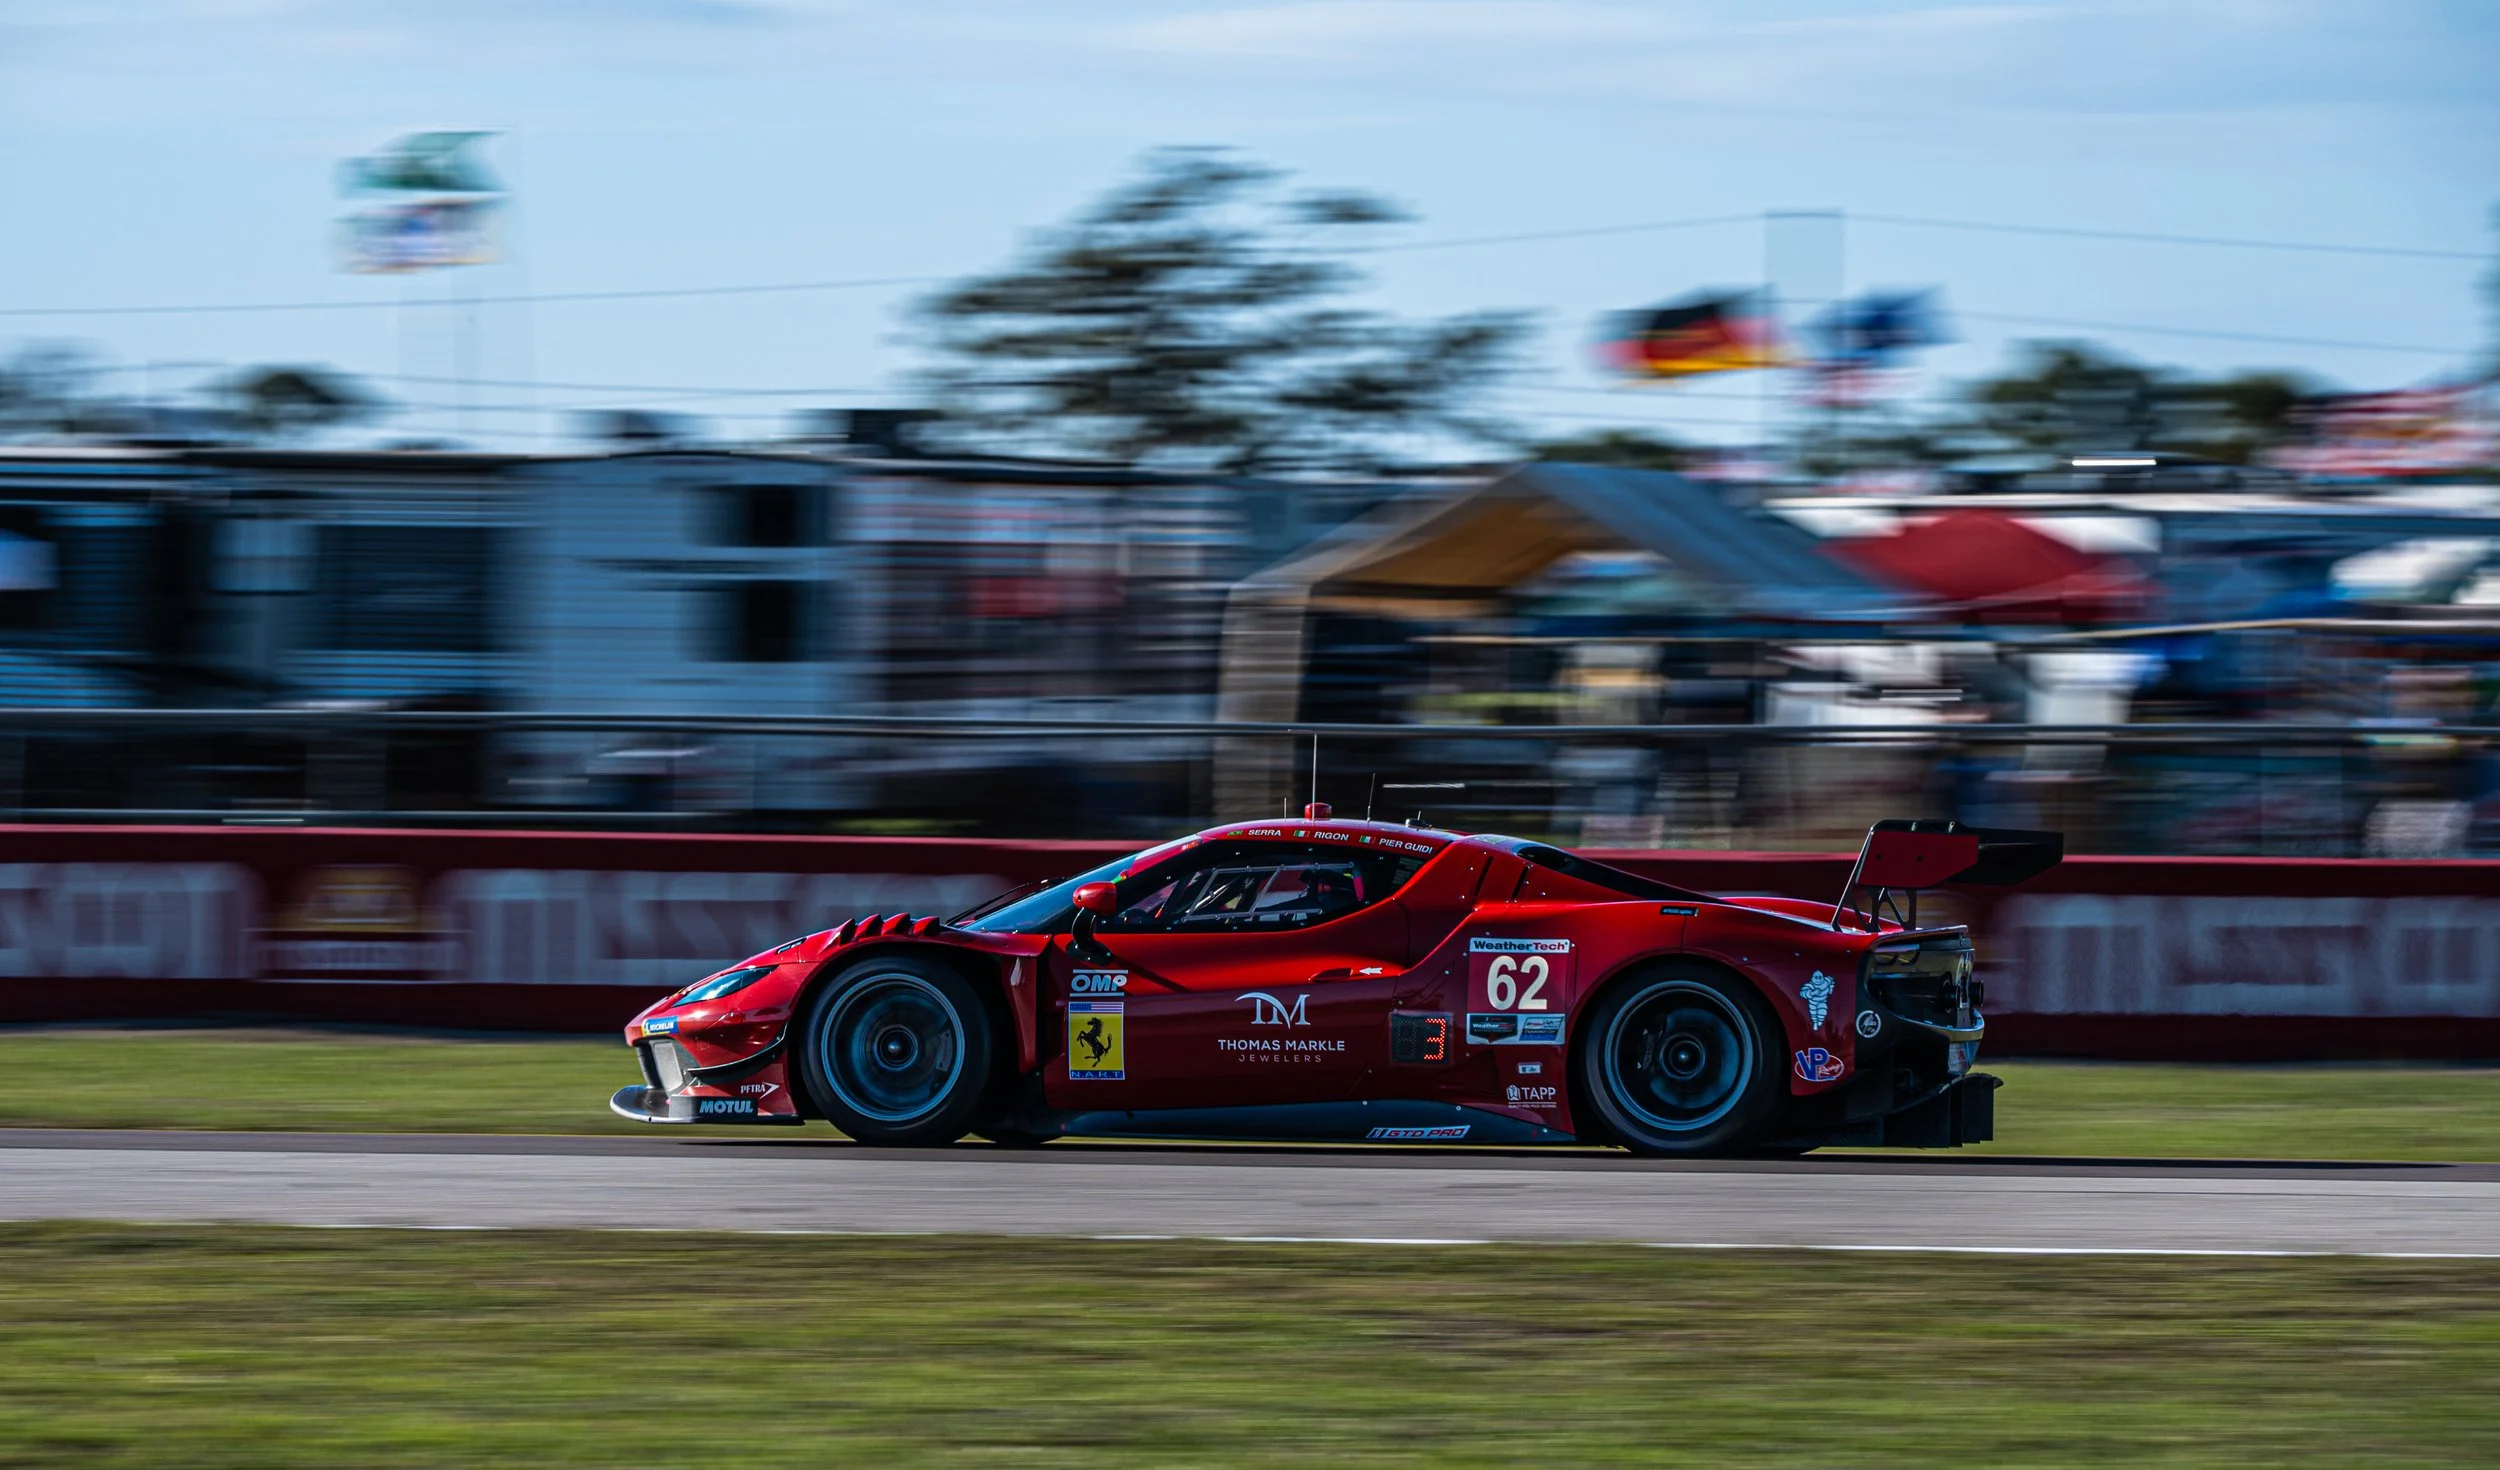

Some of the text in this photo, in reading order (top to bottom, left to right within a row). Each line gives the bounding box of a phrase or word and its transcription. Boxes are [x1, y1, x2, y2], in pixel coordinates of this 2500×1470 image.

[1248, 829, 1282, 837] SERRA
[1314, 831, 1349, 841] RIGON
[1378, 838, 1433, 854] PIER GUIDI
[1473, 941, 1565, 951] WeatherTech
[1071, 974, 1127, 992] OMP
[1487, 955, 1549, 1011] 62
[1218, 1039, 1346, 1051] THOMAS MARKLE
[1424, 1018, 1446, 1060] 3
[1238, 1054, 1322, 1063] JEWELERS
[1795, 1047, 1829, 1081] VP
[1521, 1087, 1556, 1100] TAPP
[699, 1100, 754, 1114] MOTUL
[1387, 1129, 1463, 1137] GTD PRO
